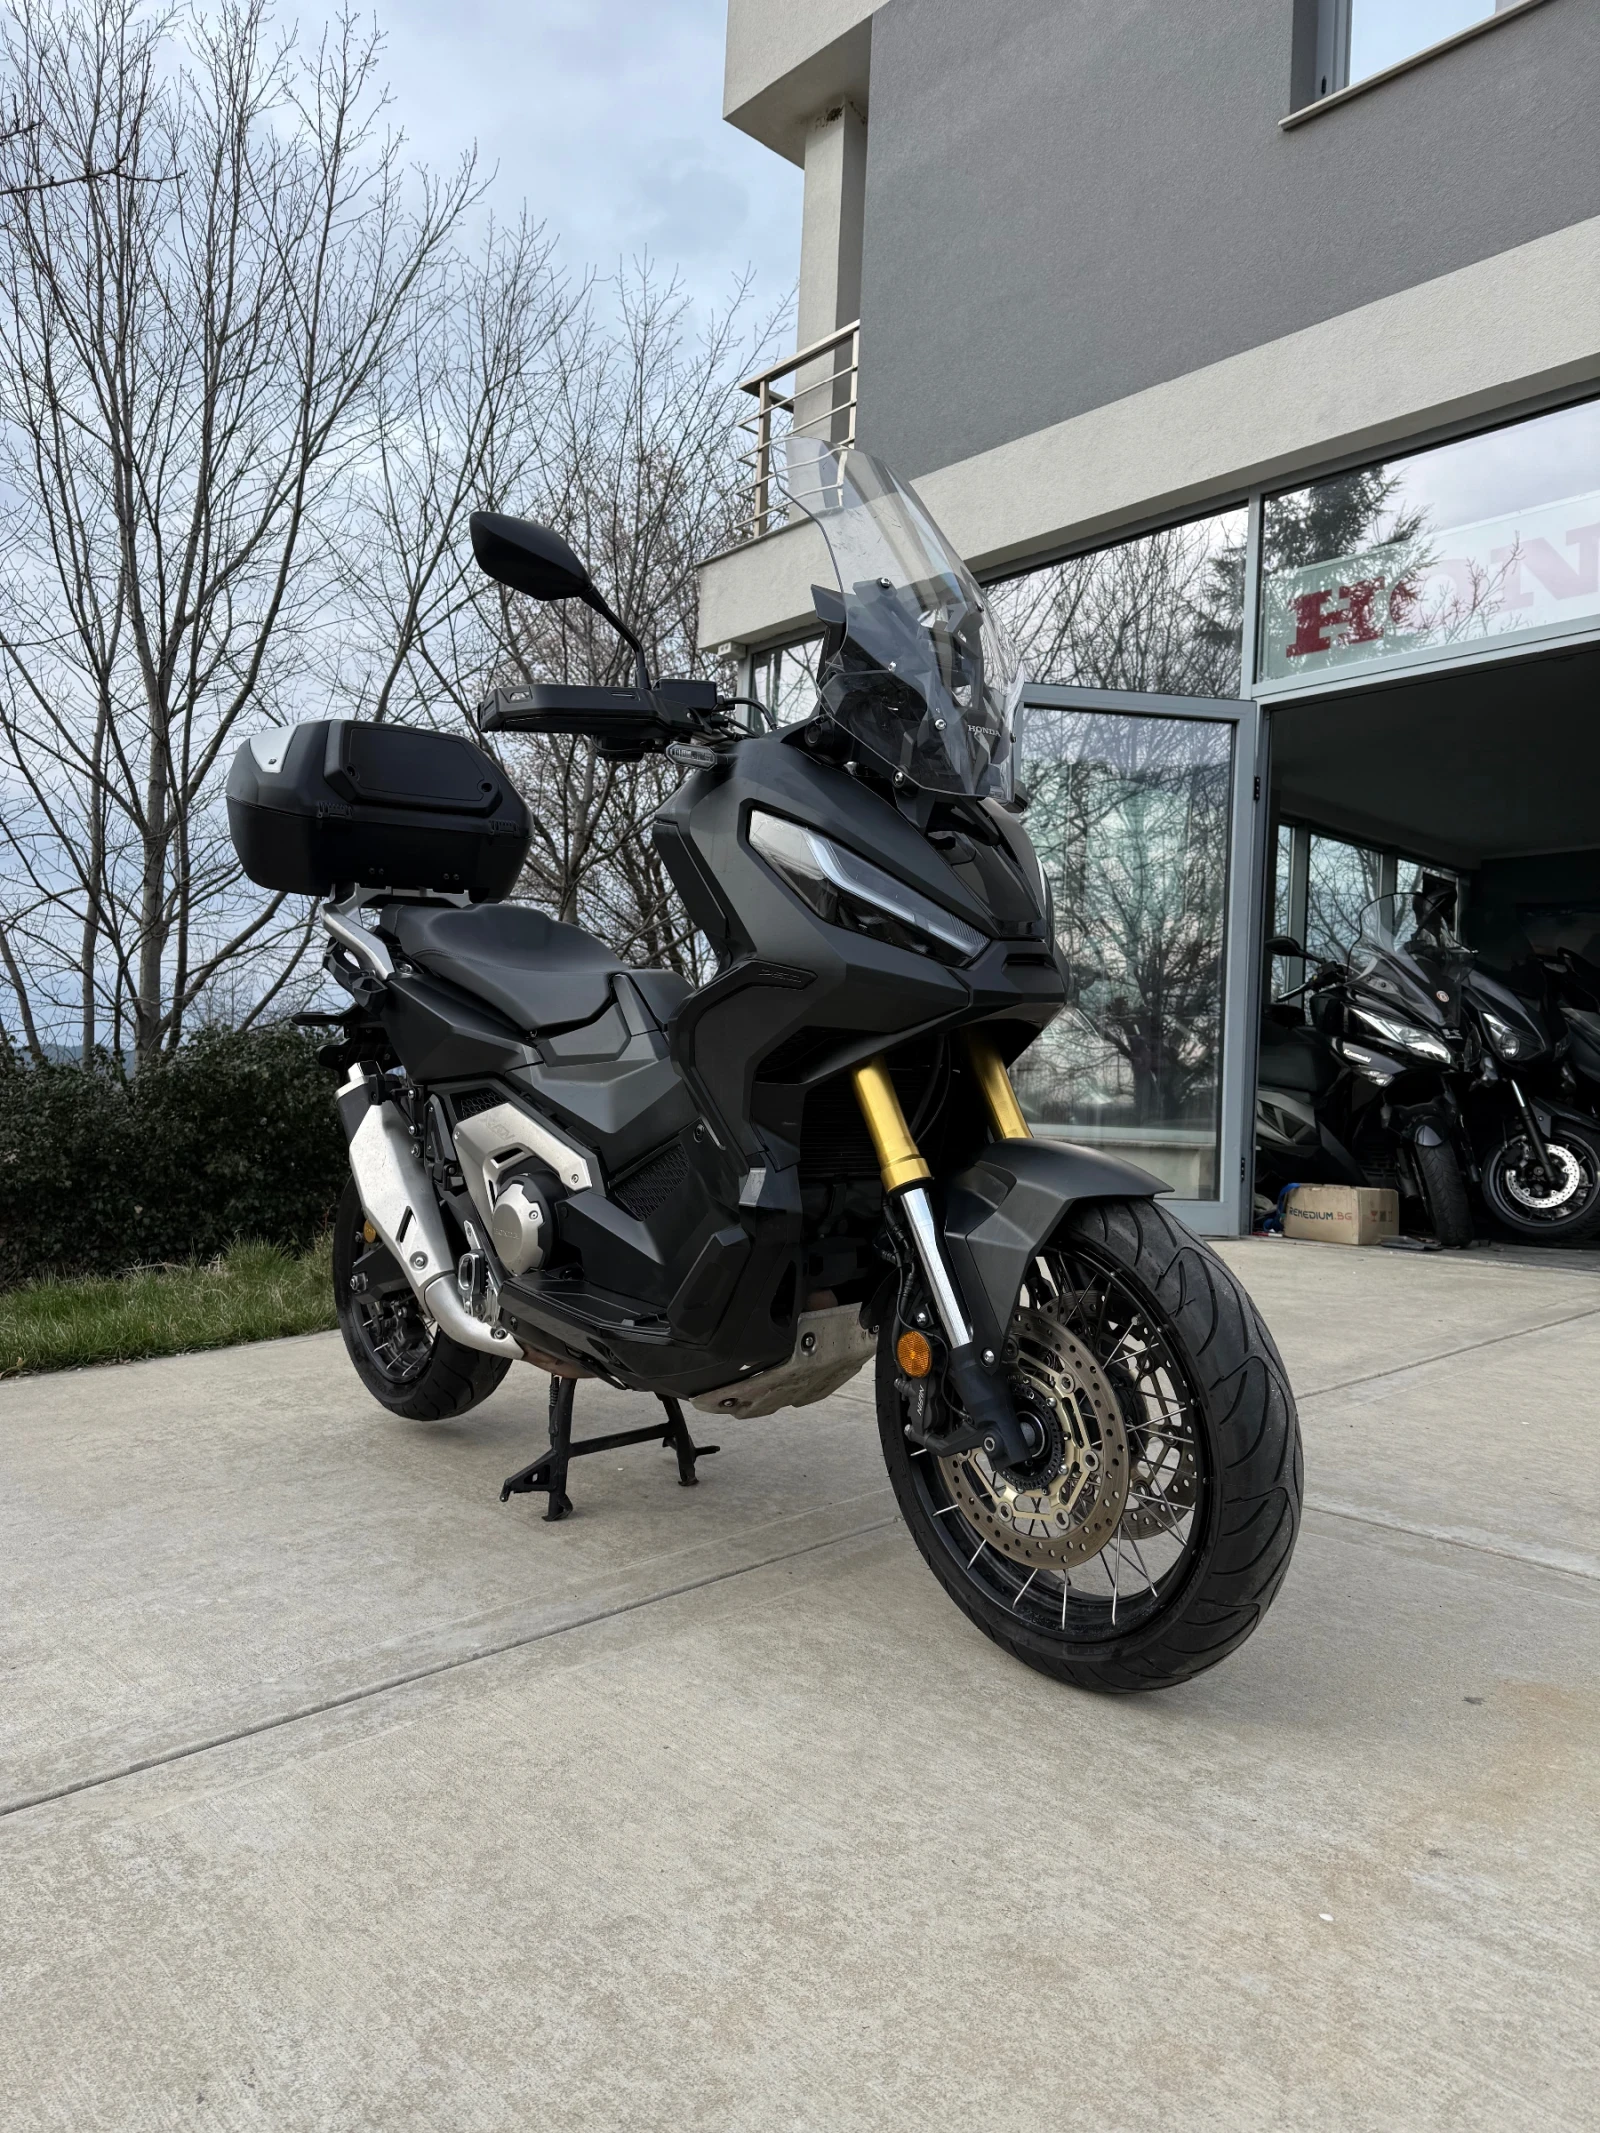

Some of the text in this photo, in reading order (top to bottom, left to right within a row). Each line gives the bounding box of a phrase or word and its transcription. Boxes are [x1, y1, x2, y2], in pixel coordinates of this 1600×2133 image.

[967, 724, 1001, 738] HONDA
[1289, 1206, 1352, 1220] REMEDIUM.BG
[916, 1384, 925, 1417] NISSIN
